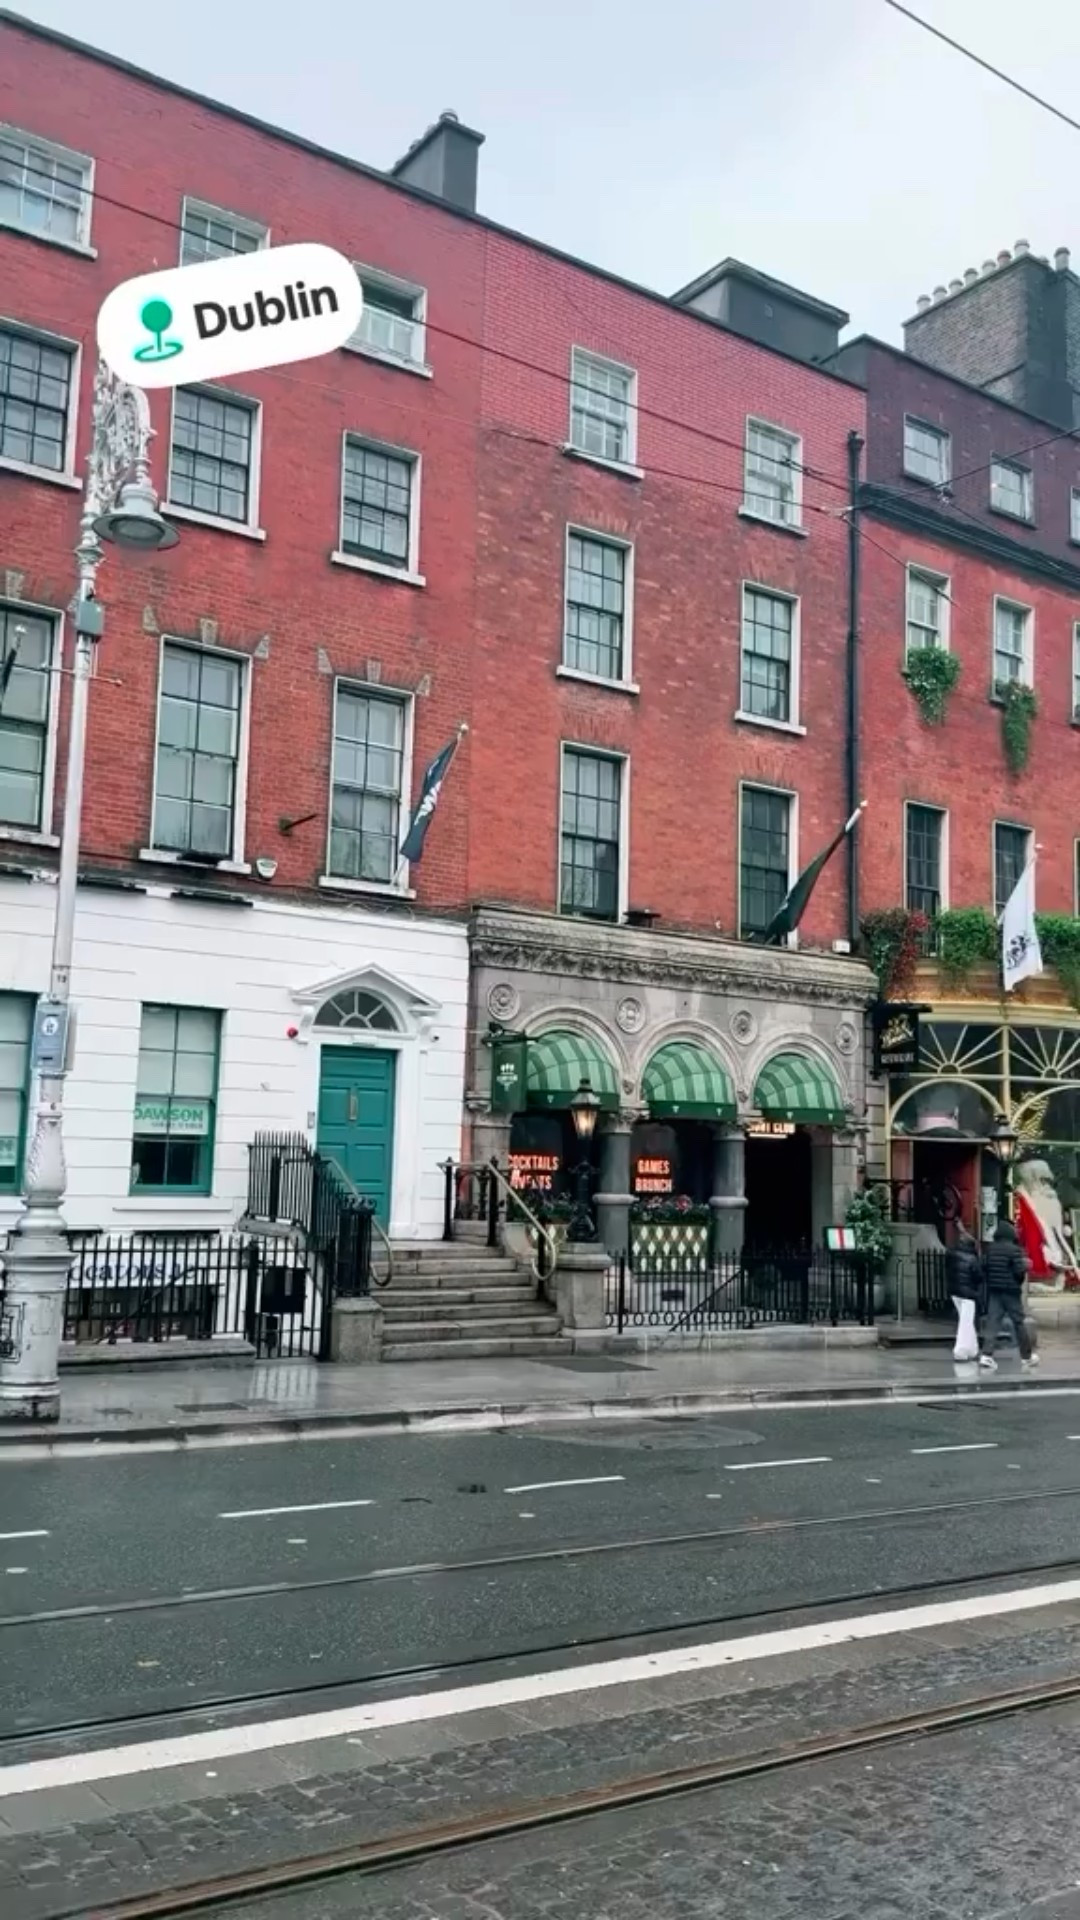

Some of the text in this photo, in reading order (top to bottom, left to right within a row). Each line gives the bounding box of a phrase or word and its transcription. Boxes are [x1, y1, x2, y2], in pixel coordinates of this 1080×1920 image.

[134, 1107, 204, 1122] DAWSON
[508, 1154, 560, 1170] COCKTAILS
[638, 1159, 670, 1174] GAMES
[635, 1178, 672, 1192] BRUNCH
